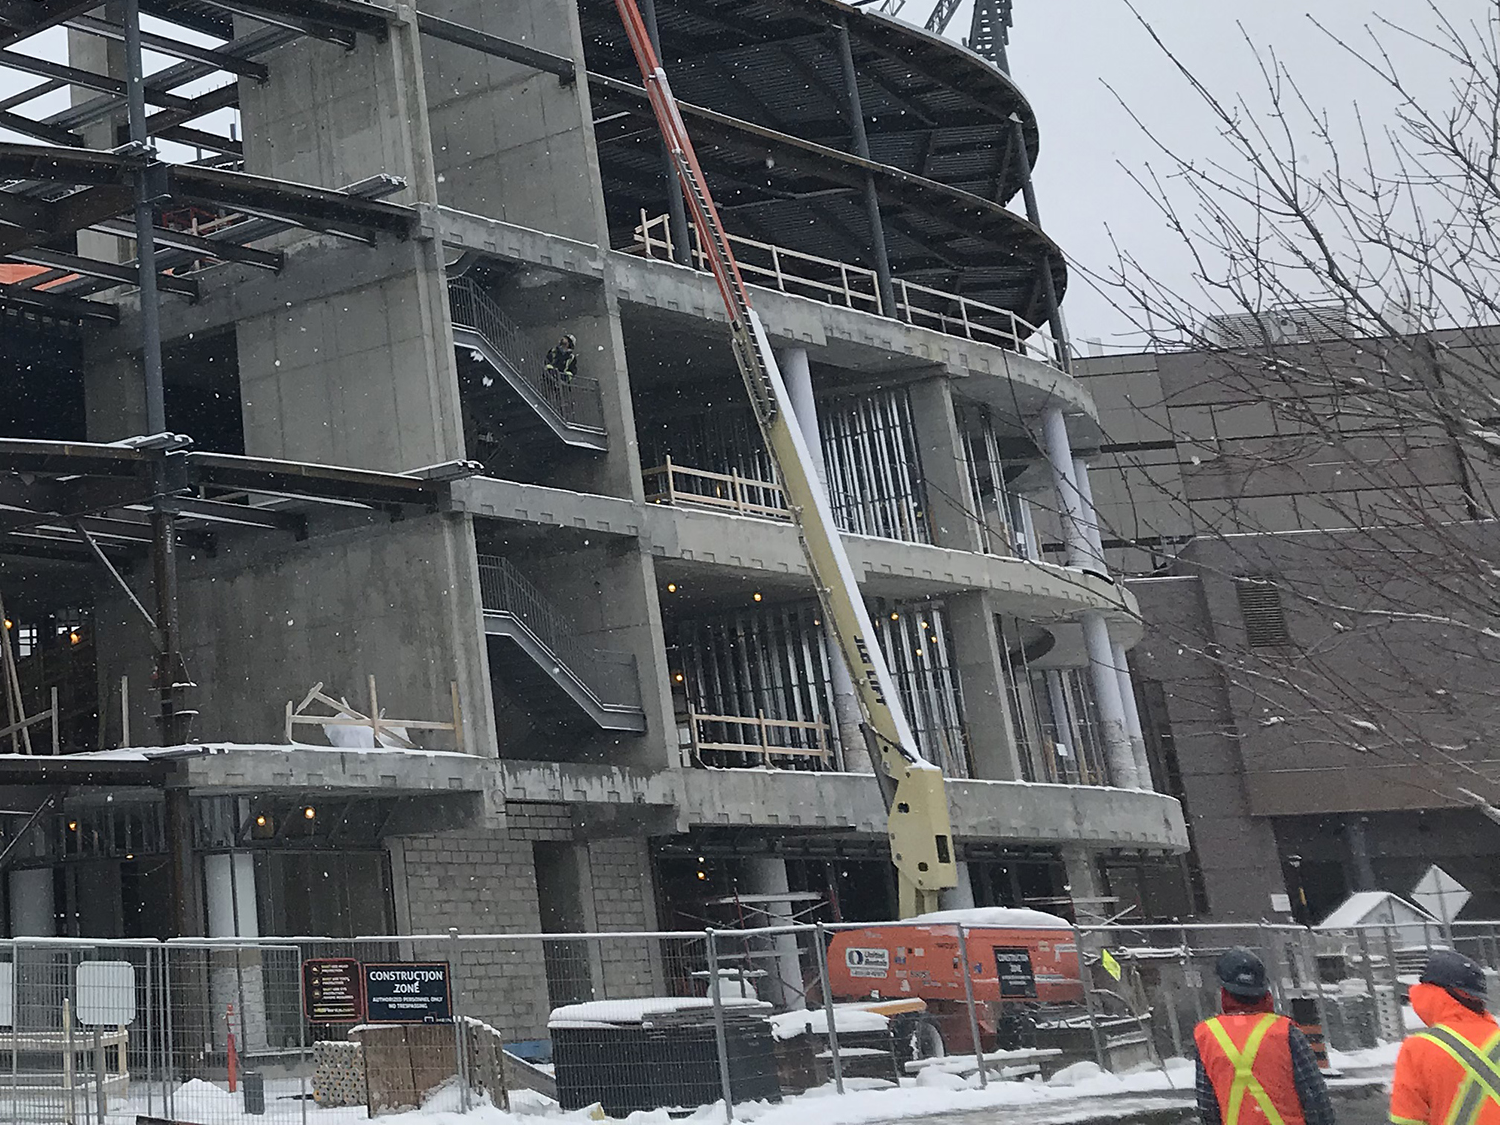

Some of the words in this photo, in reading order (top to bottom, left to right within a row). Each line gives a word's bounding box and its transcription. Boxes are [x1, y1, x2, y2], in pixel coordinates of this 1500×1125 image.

[866, 670, 887, 706] LIFT
[369, 971, 444, 983] CONSTRUCTION
[392, 982, 421, 994] ZONE
